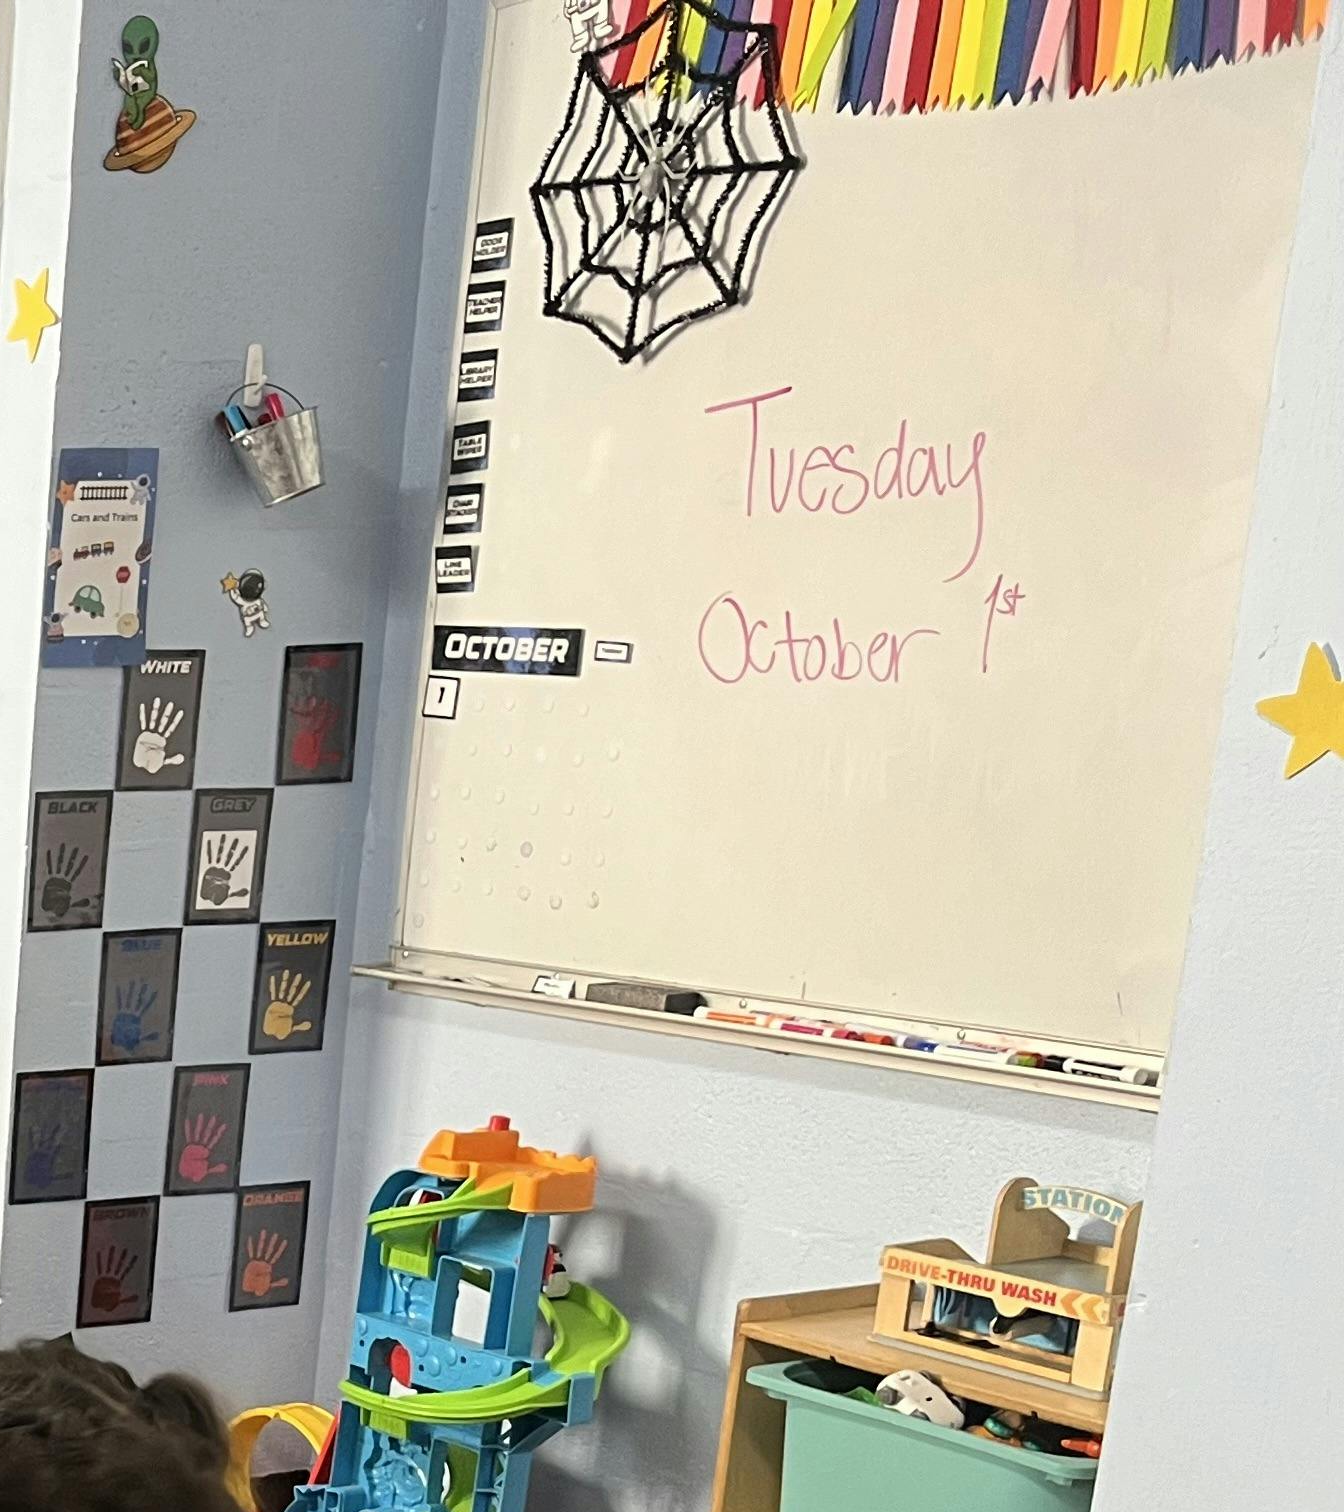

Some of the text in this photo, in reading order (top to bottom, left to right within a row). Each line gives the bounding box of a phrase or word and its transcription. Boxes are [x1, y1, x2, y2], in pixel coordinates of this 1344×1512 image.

[704, 386, 987, 583] Tuesday
[70, 512, 138, 523] Cars and Trains
[438, 569, 470, 577] LEADER
[698, 590, 941, 684] October
[444, 632, 570, 664] OCTOBER
[140, 659, 192, 675] WHITE
[438, 686, 446, 704] 1
[47, 800, 98, 815] BLACK
[210, 798, 258, 814] GREY
[264, 930, 329, 947] YELLOW
[886, 1255, 1058, 1307] DRIVE-THRU WASH
